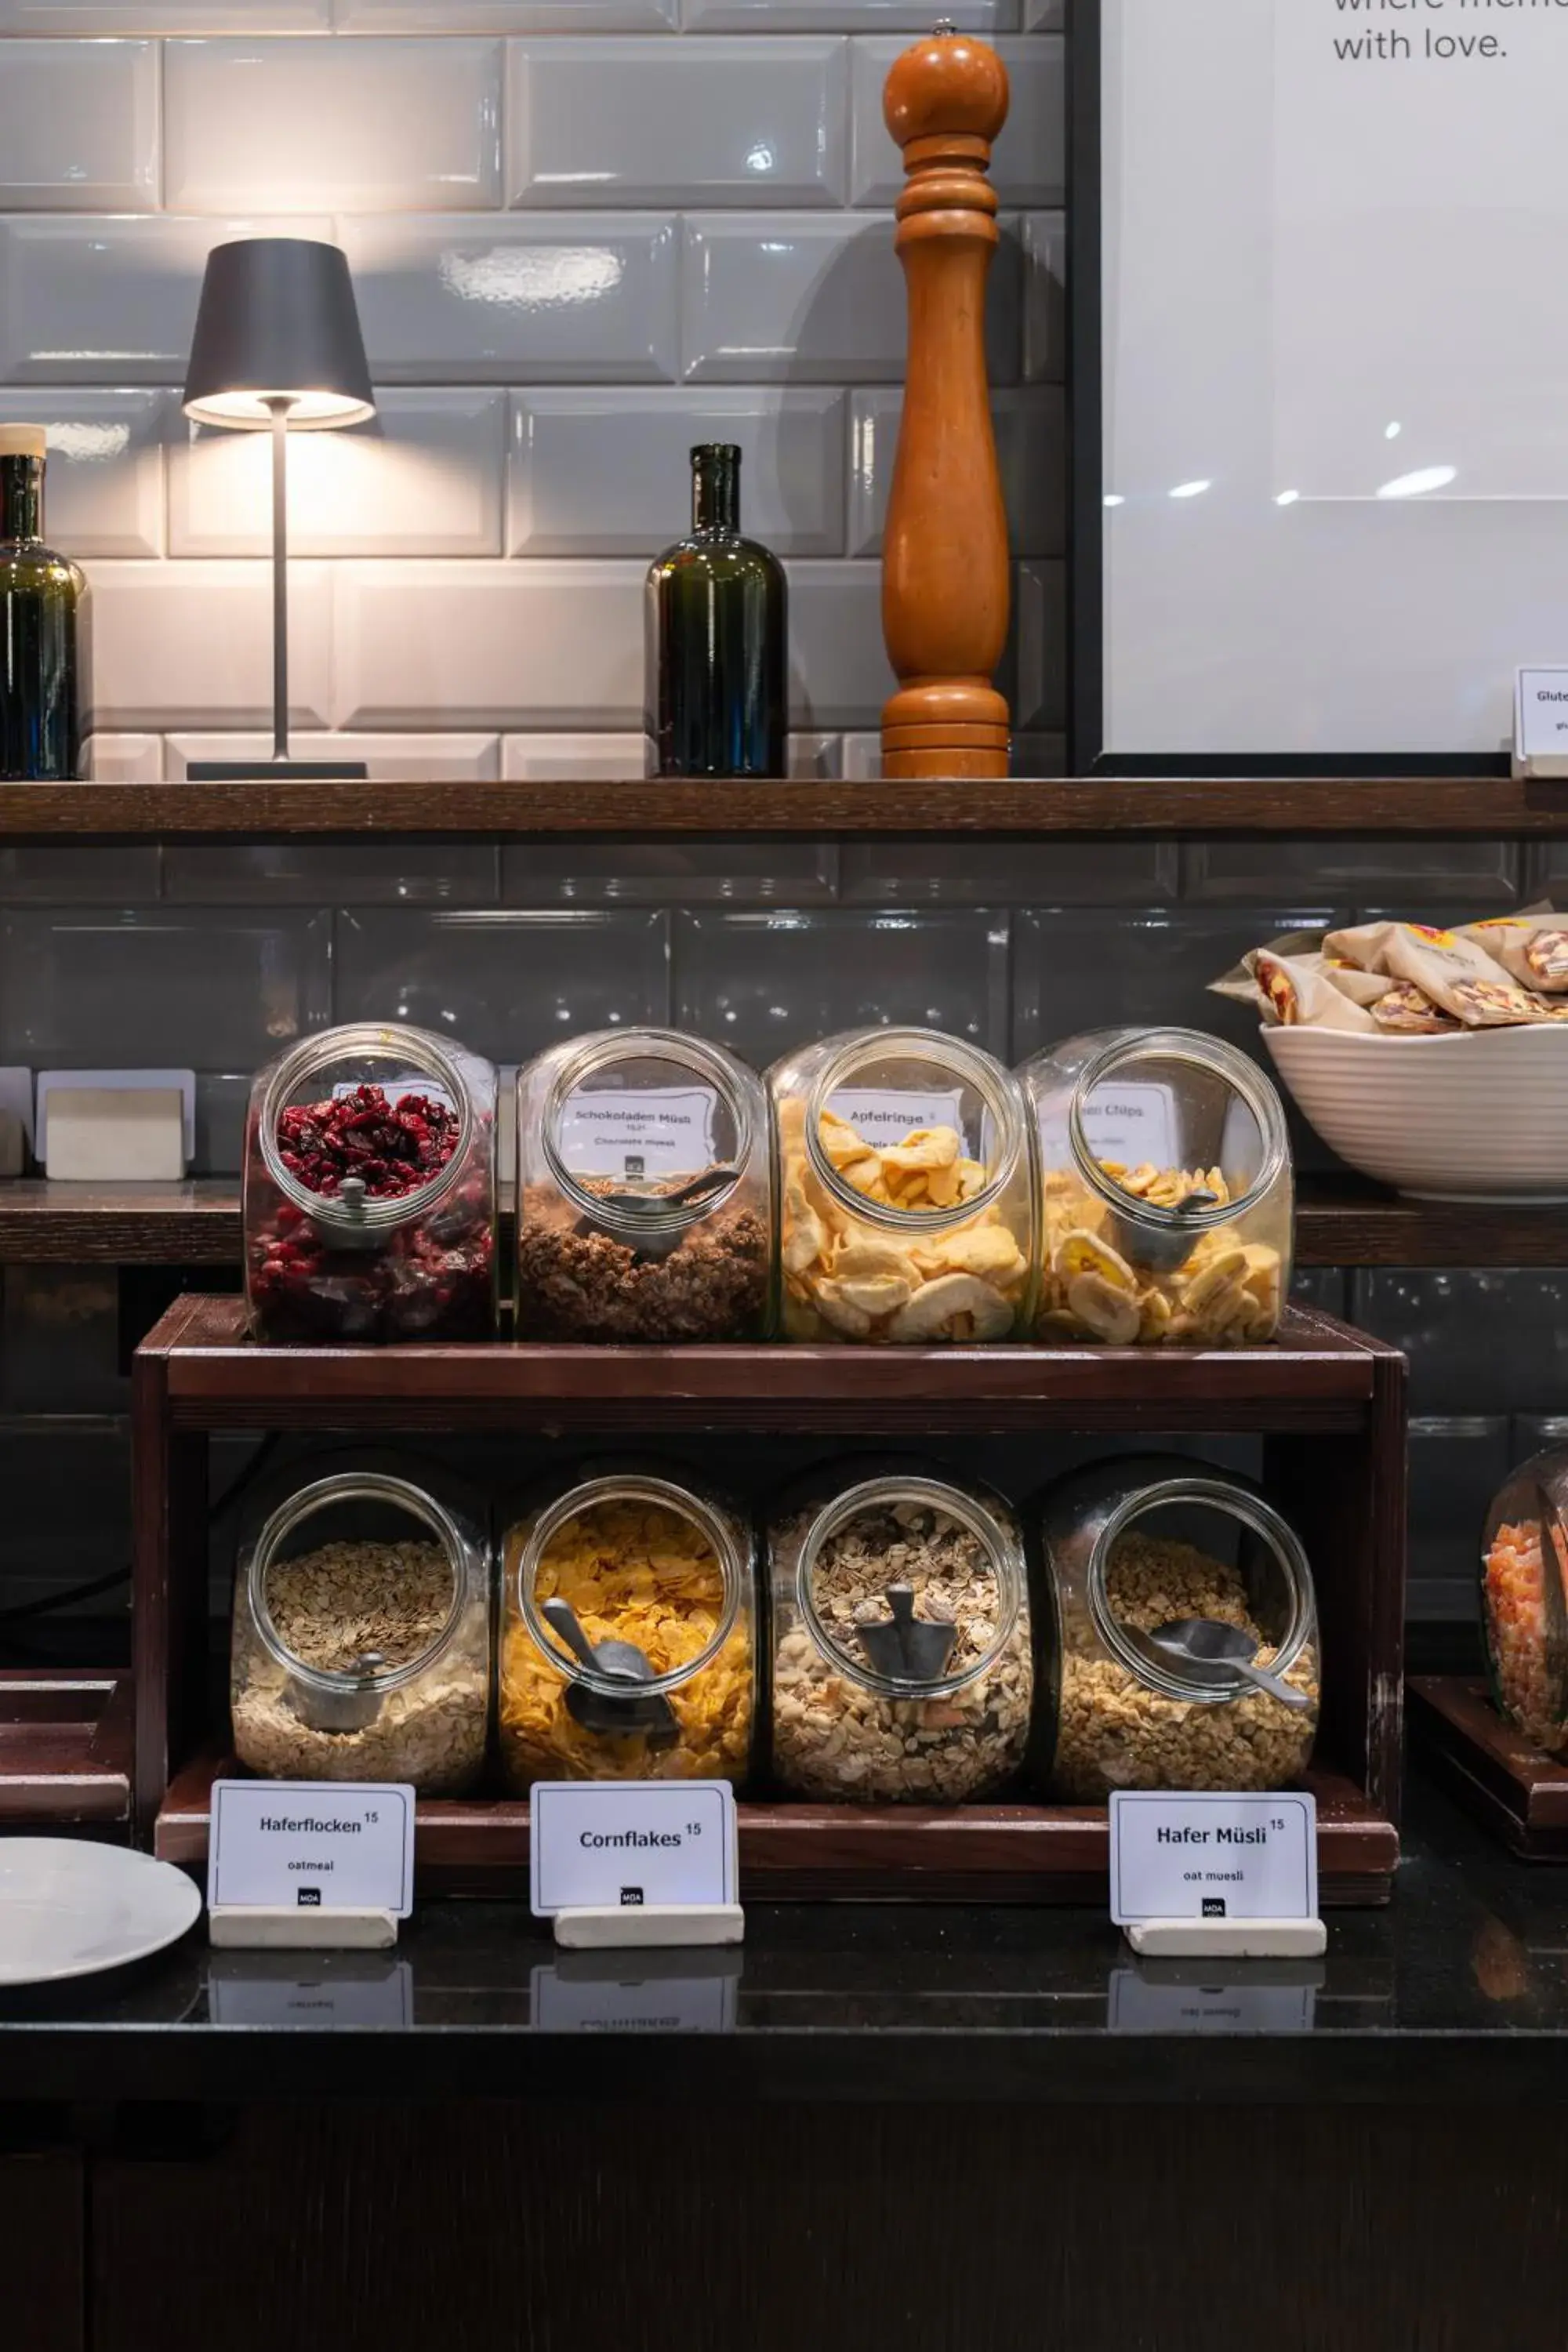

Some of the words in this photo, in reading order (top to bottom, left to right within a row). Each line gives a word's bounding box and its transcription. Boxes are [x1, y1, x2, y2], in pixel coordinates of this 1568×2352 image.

[1334, 28, 1410, 60] with
[1425, 28, 1507, 58] love.
[575, 1110, 655, 1121] Schokoladen
[851, 1110, 924, 1124] Apfelringe
[260, 1817, 361, 1833] Haferflocken
[365, 1812, 379, 1824] 15
[1156, 1827, 1210, 1844] Hafer
[1216, 1825, 1267, 1844] Müsli
[1270, 1818, 1285, 1831] 15
[579, 1831, 681, 1848] Cornflakes
[685, 1823, 702, 1836] 15
[288, 1860, 334, 1871] oatmeal
[1183, 1871, 1202, 1882] oat
[1206, 1871, 1244, 1882] muesli
